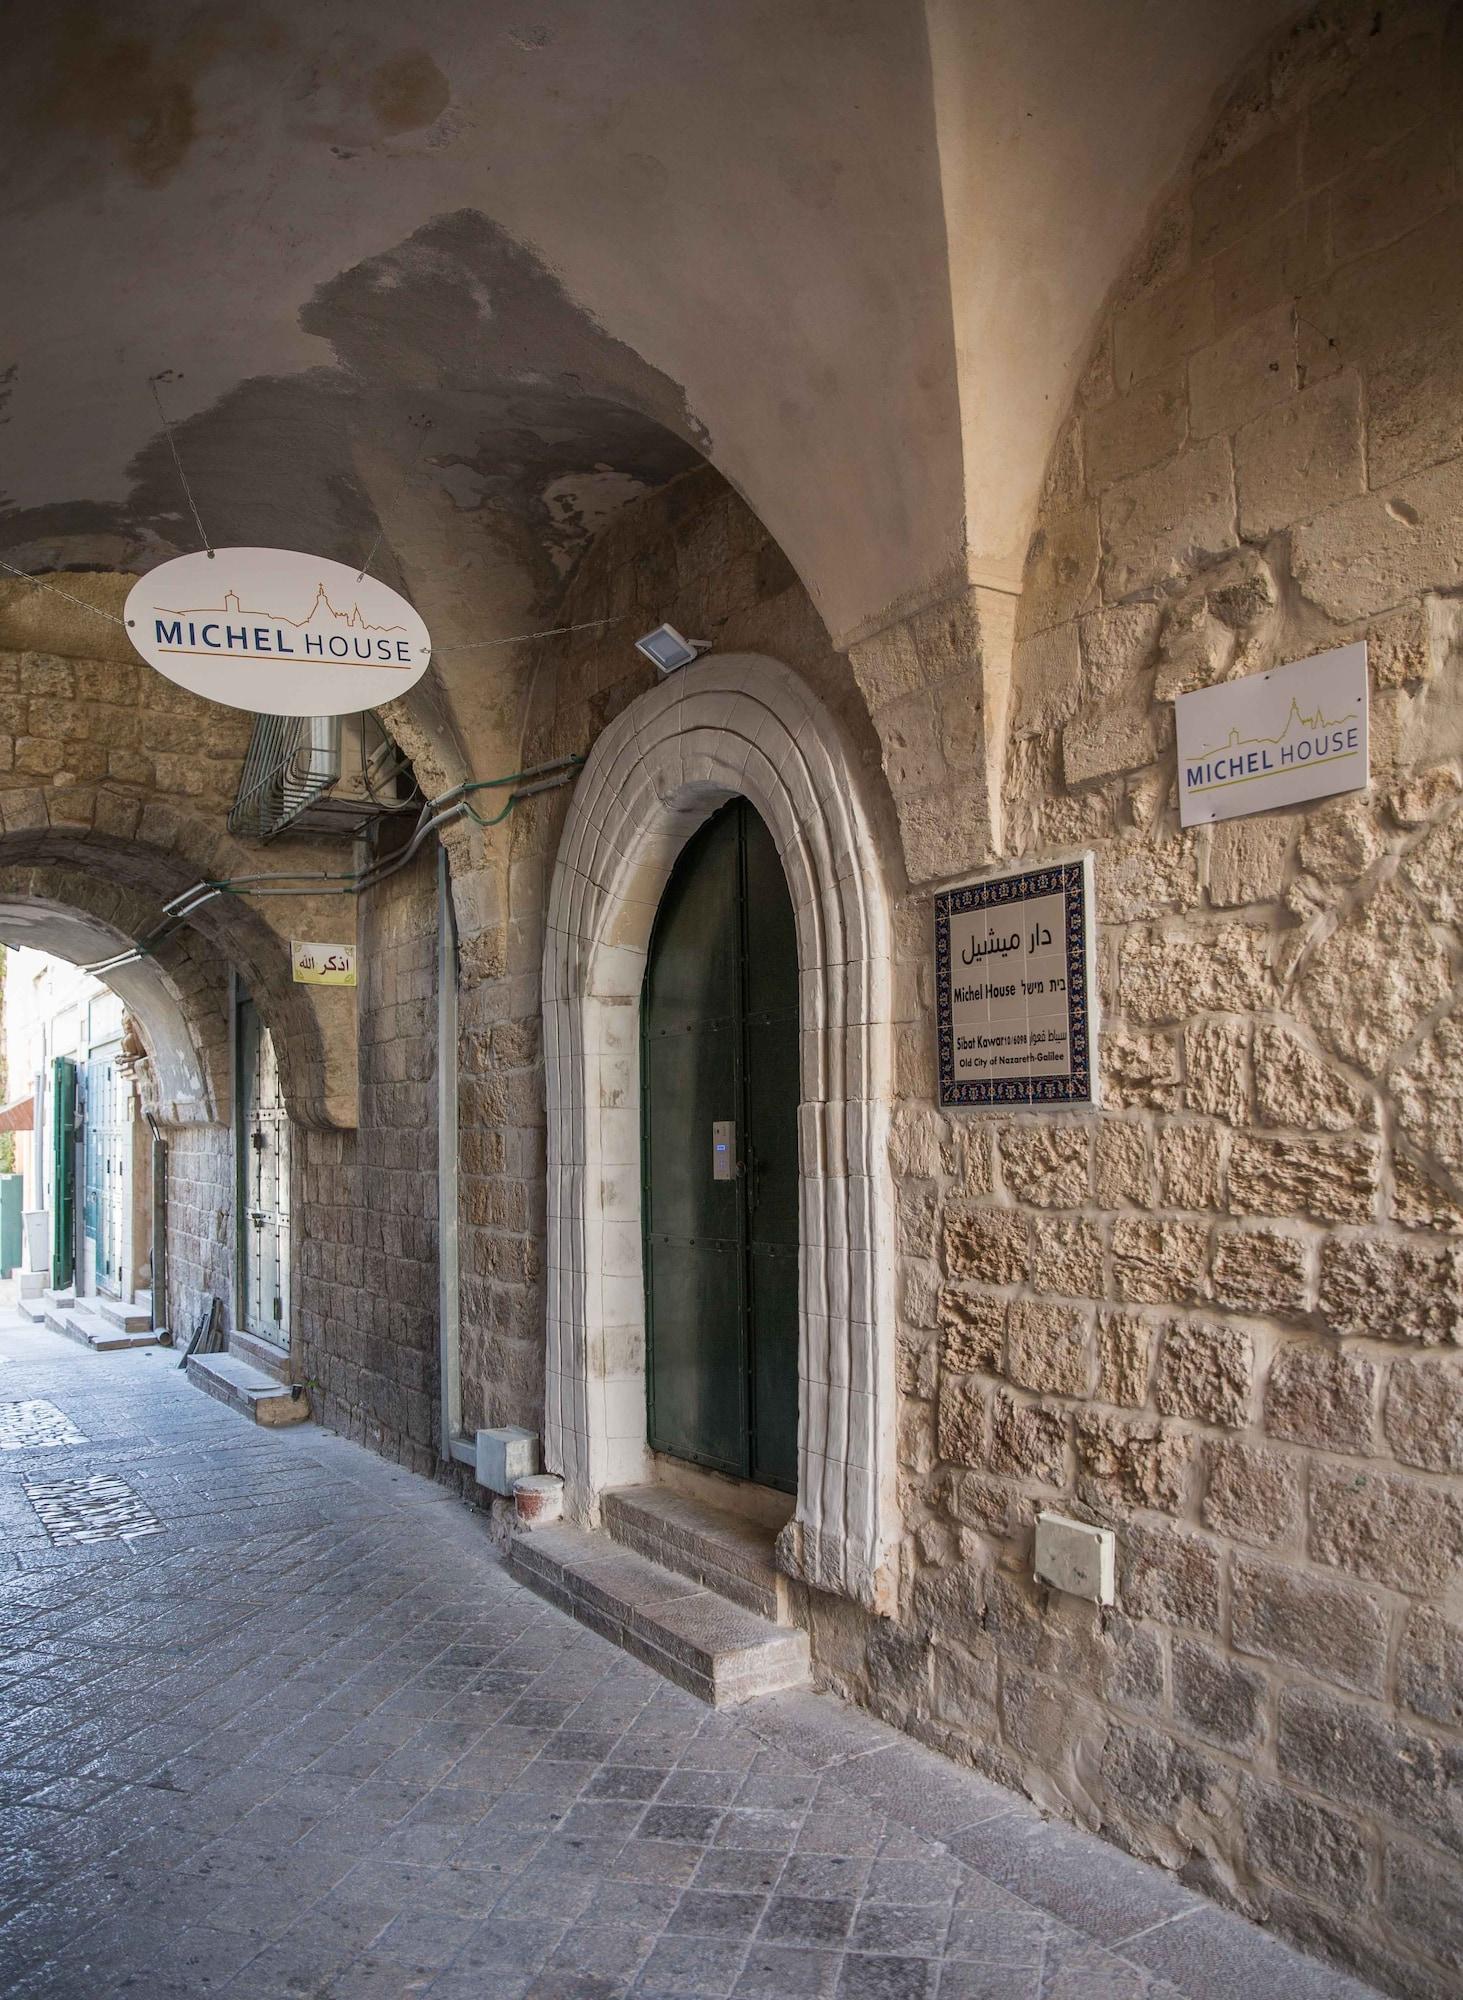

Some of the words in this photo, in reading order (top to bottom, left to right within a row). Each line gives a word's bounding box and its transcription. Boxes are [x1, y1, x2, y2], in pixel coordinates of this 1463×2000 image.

[155, 620, 294, 652] MICHEL
[305, 633, 411, 662] HOUSE
[1187, 750, 1274, 787] MICHEL
[1281, 728, 1358, 765] HOUSE
[962, 928, 1020, 965] ميشيل
[1029, 923, 1052, 954] دار
[300, 955, 315, 969] الله
[318, 956, 349, 975] اذكر
[954, 984, 983, 1003] Michel
[986, 984, 1016, 999] House
[1021, 980, 1044, 995] מישל
[1049, 978, 1066, 993] בית
[957, 1036, 976, 1050] Sibat
[977, 1035, 1004, 1048] Kawar
[960, 1057, 972, 1067] Old
[974, 1056, 987, 1068] City
[990, 1056, 998, 1065] of
